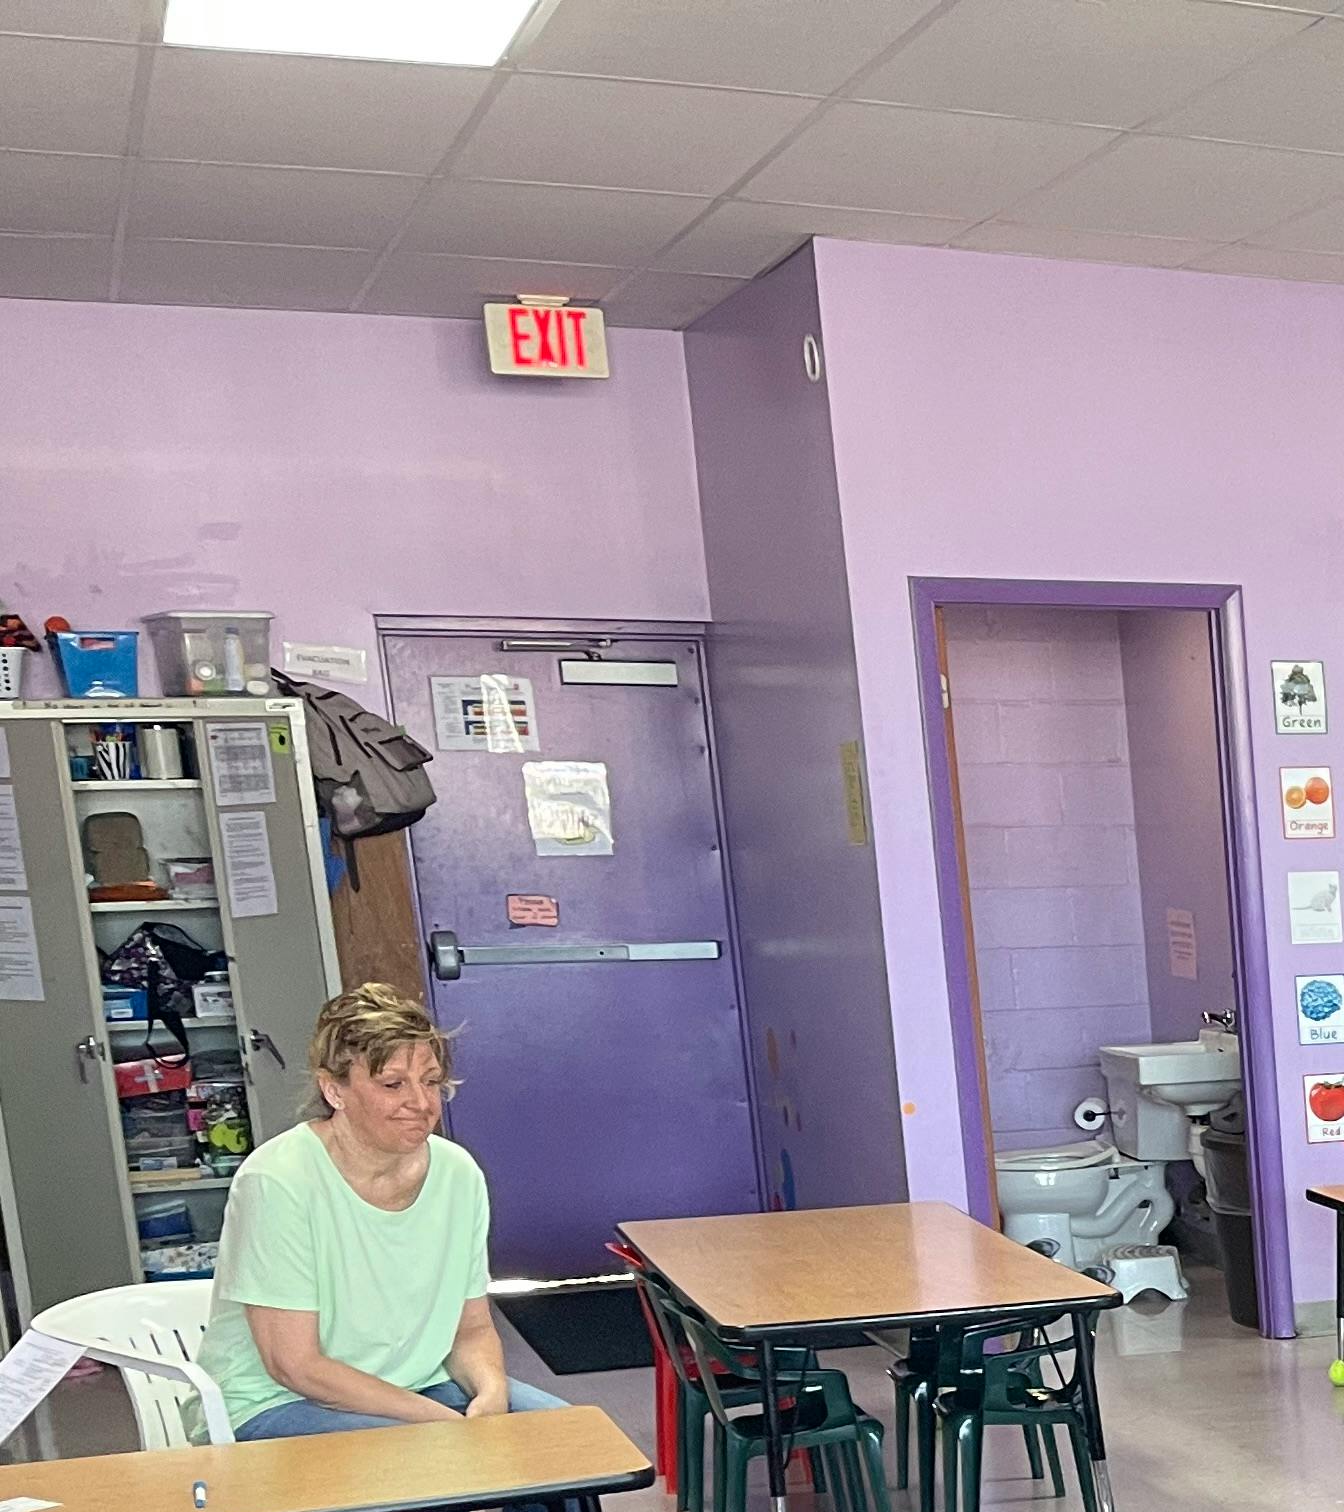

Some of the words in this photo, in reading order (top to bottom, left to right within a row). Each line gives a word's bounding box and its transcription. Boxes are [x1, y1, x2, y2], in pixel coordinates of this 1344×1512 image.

[508, 309, 587, 367] EXIT
[1282, 717, 1322, 728] Green
[1290, 821, 1329, 835] Orange
[1310, 1029, 1338, 1040] Blue
[1322, 1127, 1342, 1137] Red
